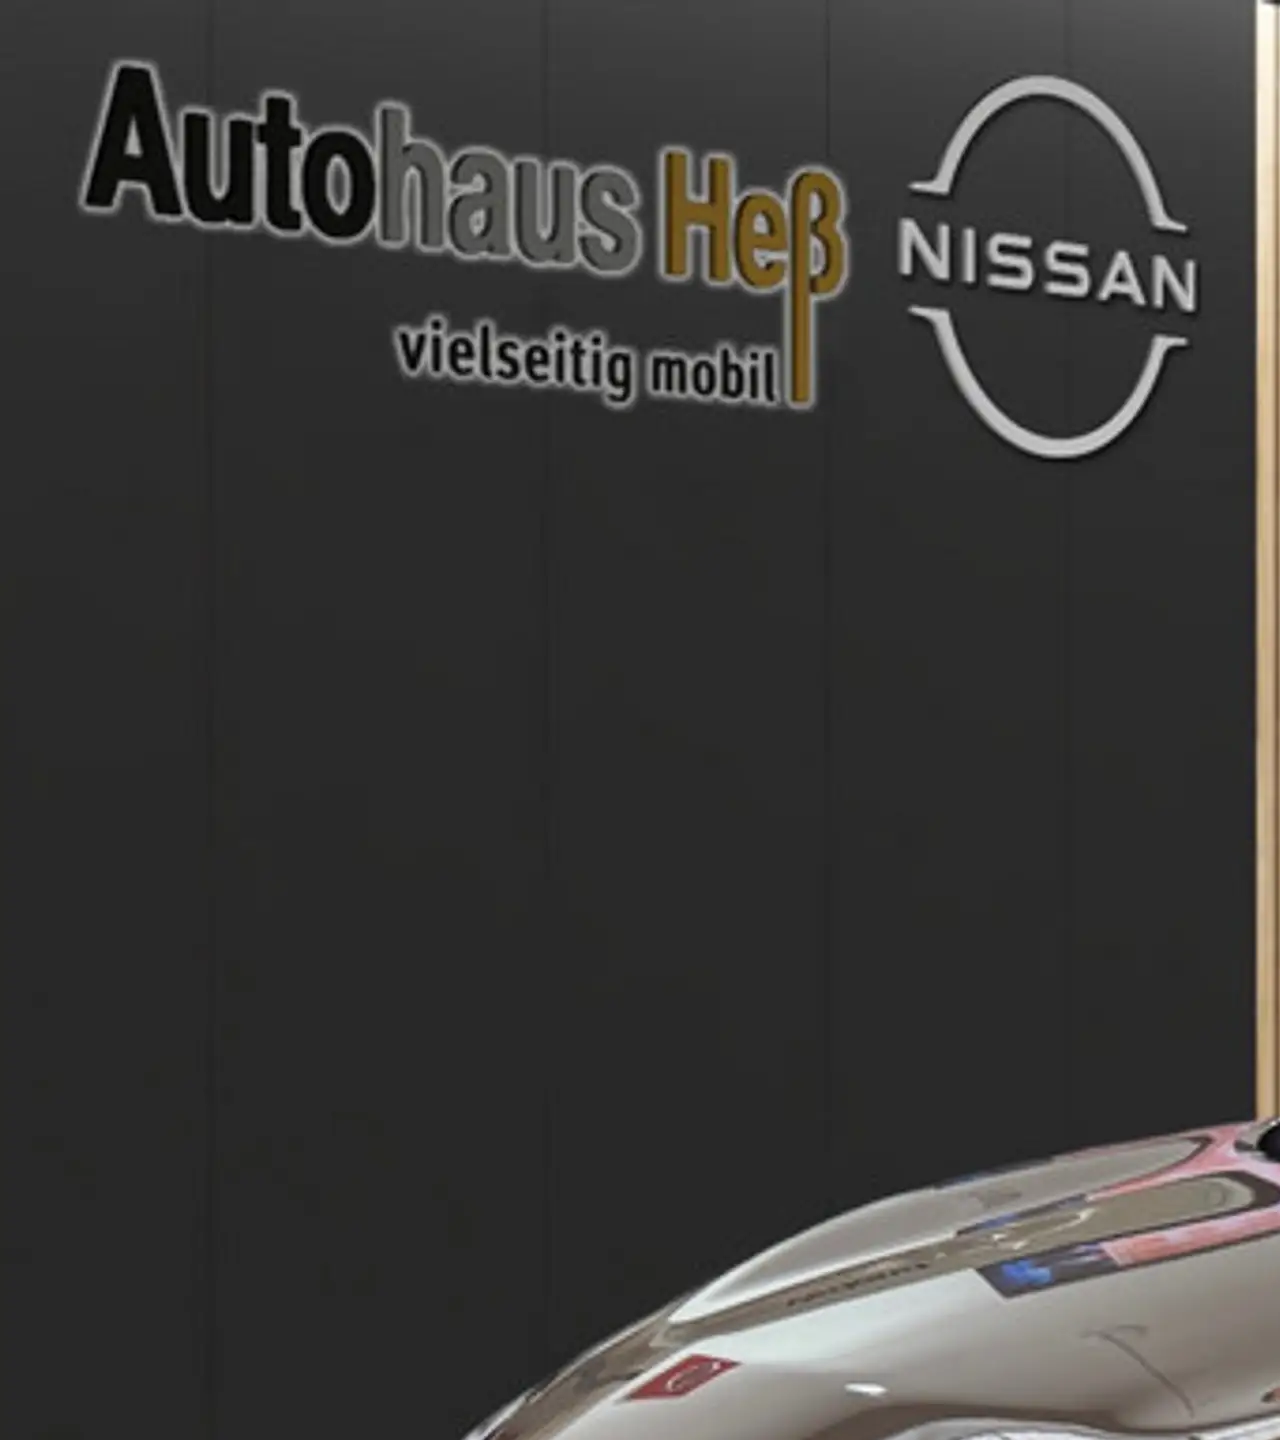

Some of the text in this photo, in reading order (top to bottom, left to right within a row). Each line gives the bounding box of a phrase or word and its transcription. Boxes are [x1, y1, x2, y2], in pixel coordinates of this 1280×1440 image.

[83, 62, 847, 406] Autohaus Heß
[898, 216, 1198, 313] NISSAN
[397, 316, 779, 402] vielseitig mobil
